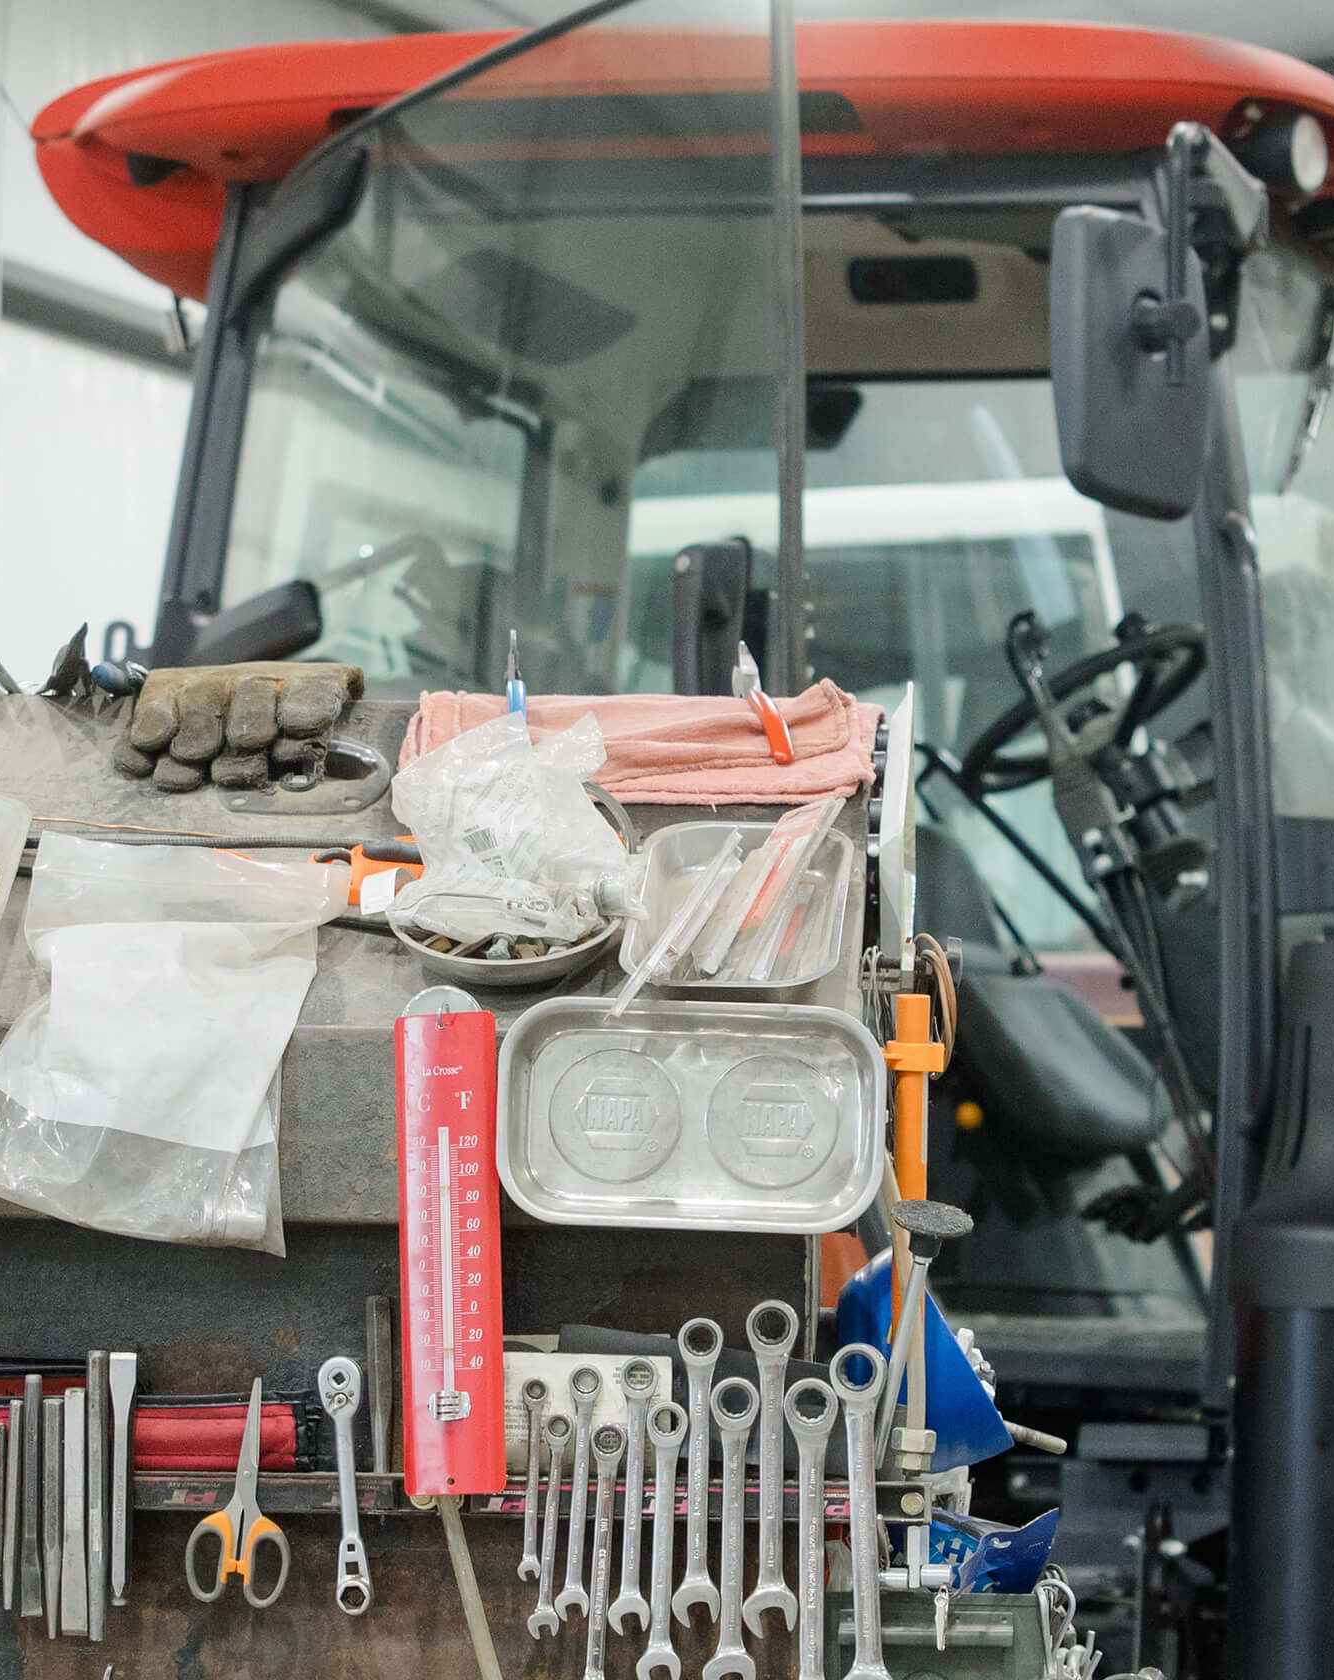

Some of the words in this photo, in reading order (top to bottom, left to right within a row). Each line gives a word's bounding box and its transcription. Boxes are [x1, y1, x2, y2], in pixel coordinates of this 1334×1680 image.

[585, 1096, 645, 1132] NAPA
[741, 1103, 803, 1138] NAPA
[458, 1136, 478, 1147] 120
[458, 1163, 479, 1174] 100
[466, 1190, 480, 1201] 80
[466, 1218, 480, 1229] 60
[467, 1246, 481, 1257] 40
[467, 1273, 482, 1284] 20
[470, 1301, 478, 1312] 0
[469, 1328, 483, 1340] 20
[469, 1356, 484, 1368] 40
